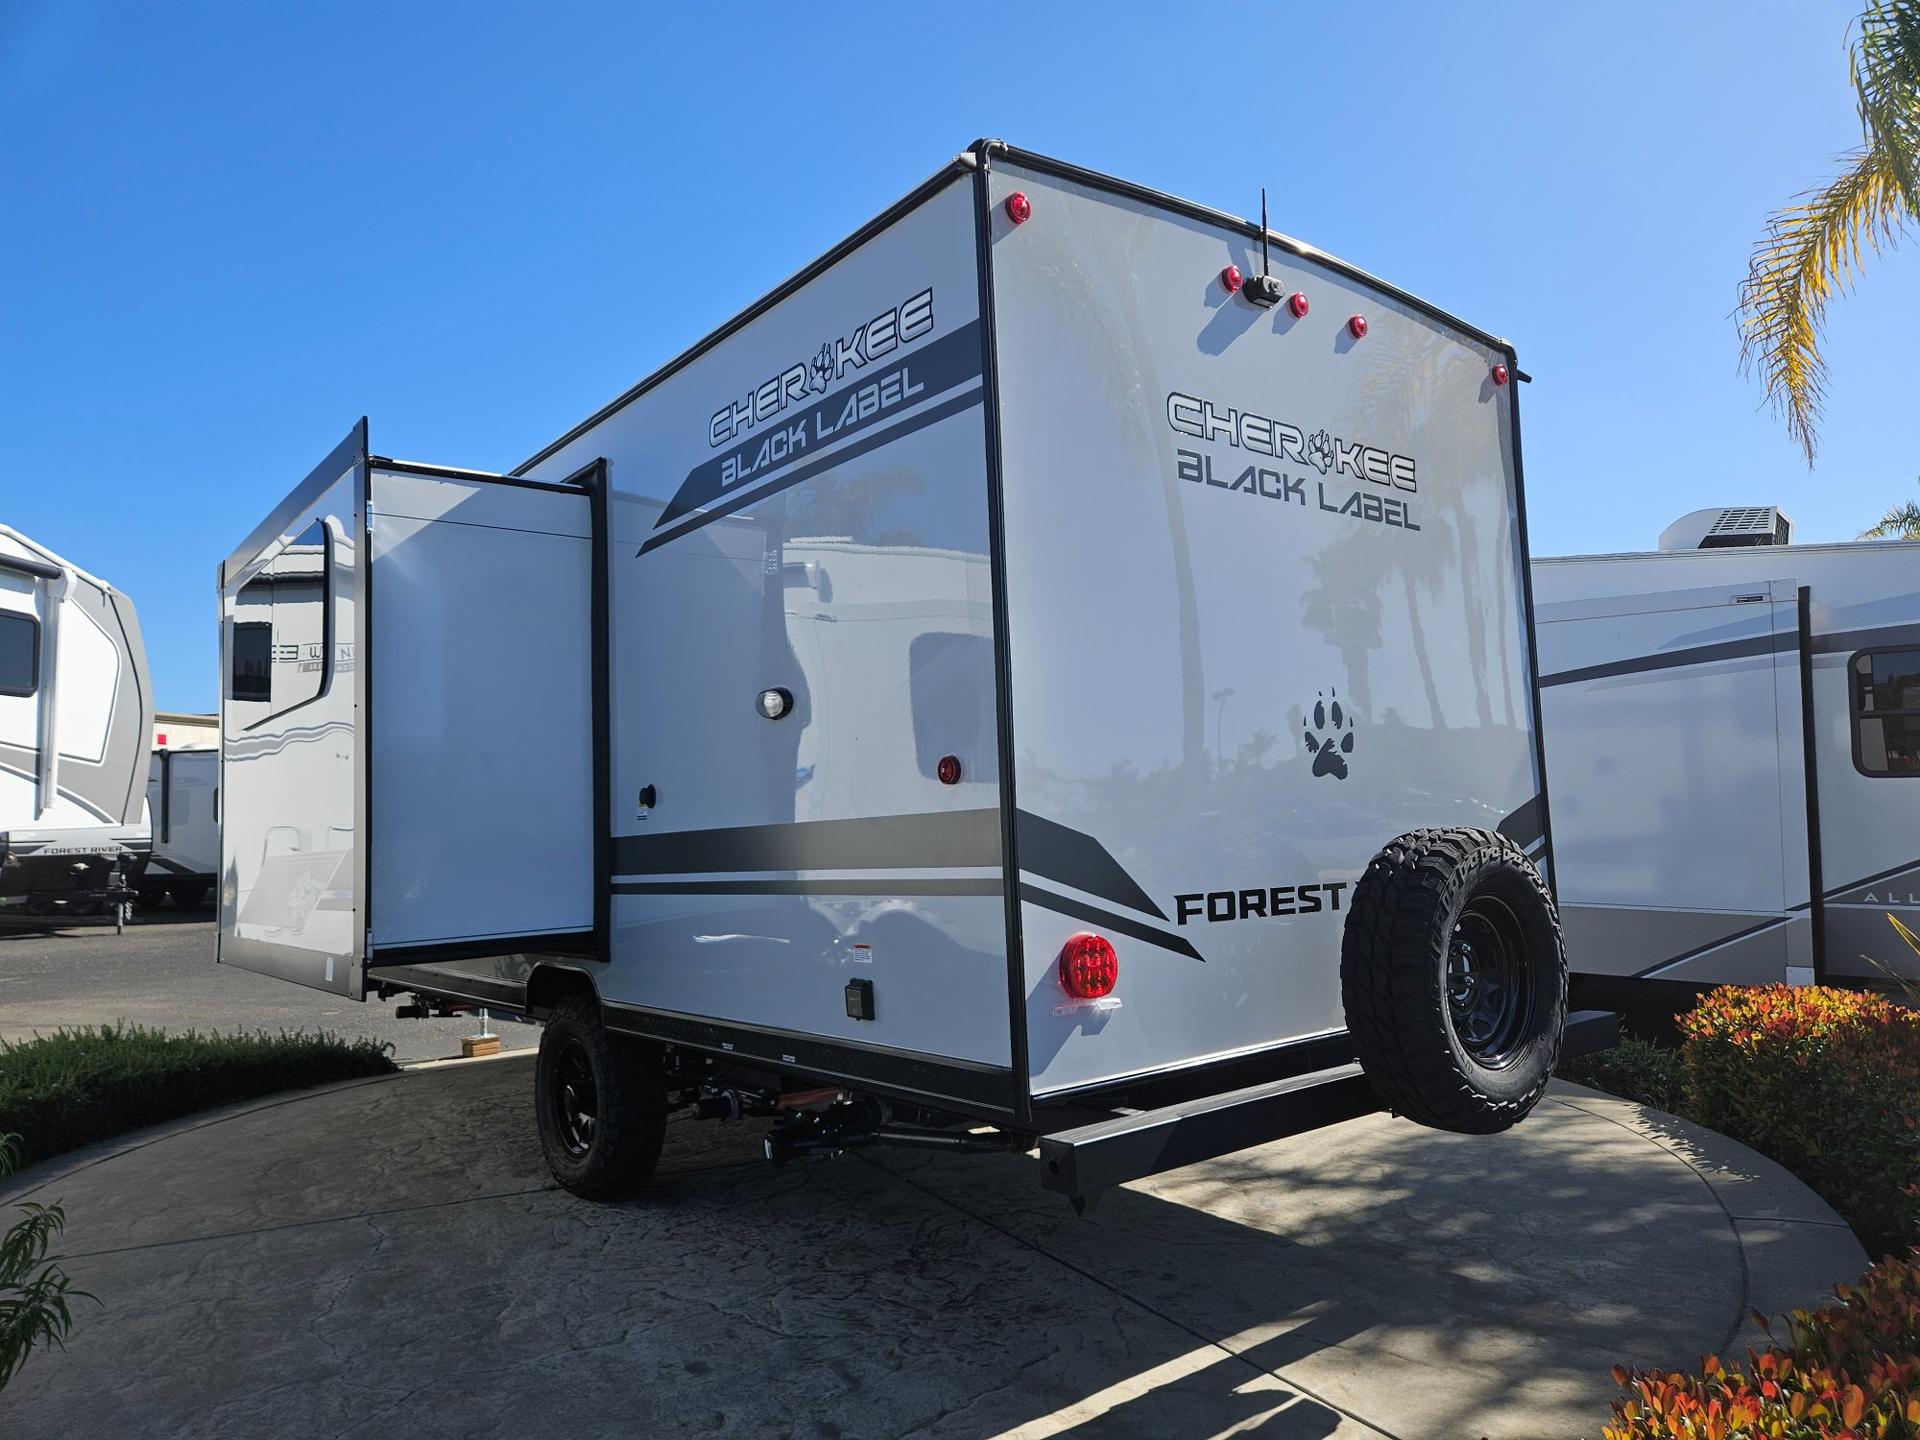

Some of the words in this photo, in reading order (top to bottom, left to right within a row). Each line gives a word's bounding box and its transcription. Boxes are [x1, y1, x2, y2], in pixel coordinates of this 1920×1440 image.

[721, 418, 808, 487] BLACK
[817, 366, 925, 440] LABEL
[1177, 448, 1306, 506] BLACK
[1317, 481, 1421, 531] LABEL
[43, 846, 87, 855] FOREST
[90, 845, 123, 854] RIVER
[1173, 882, 1348, 926] FOREST
